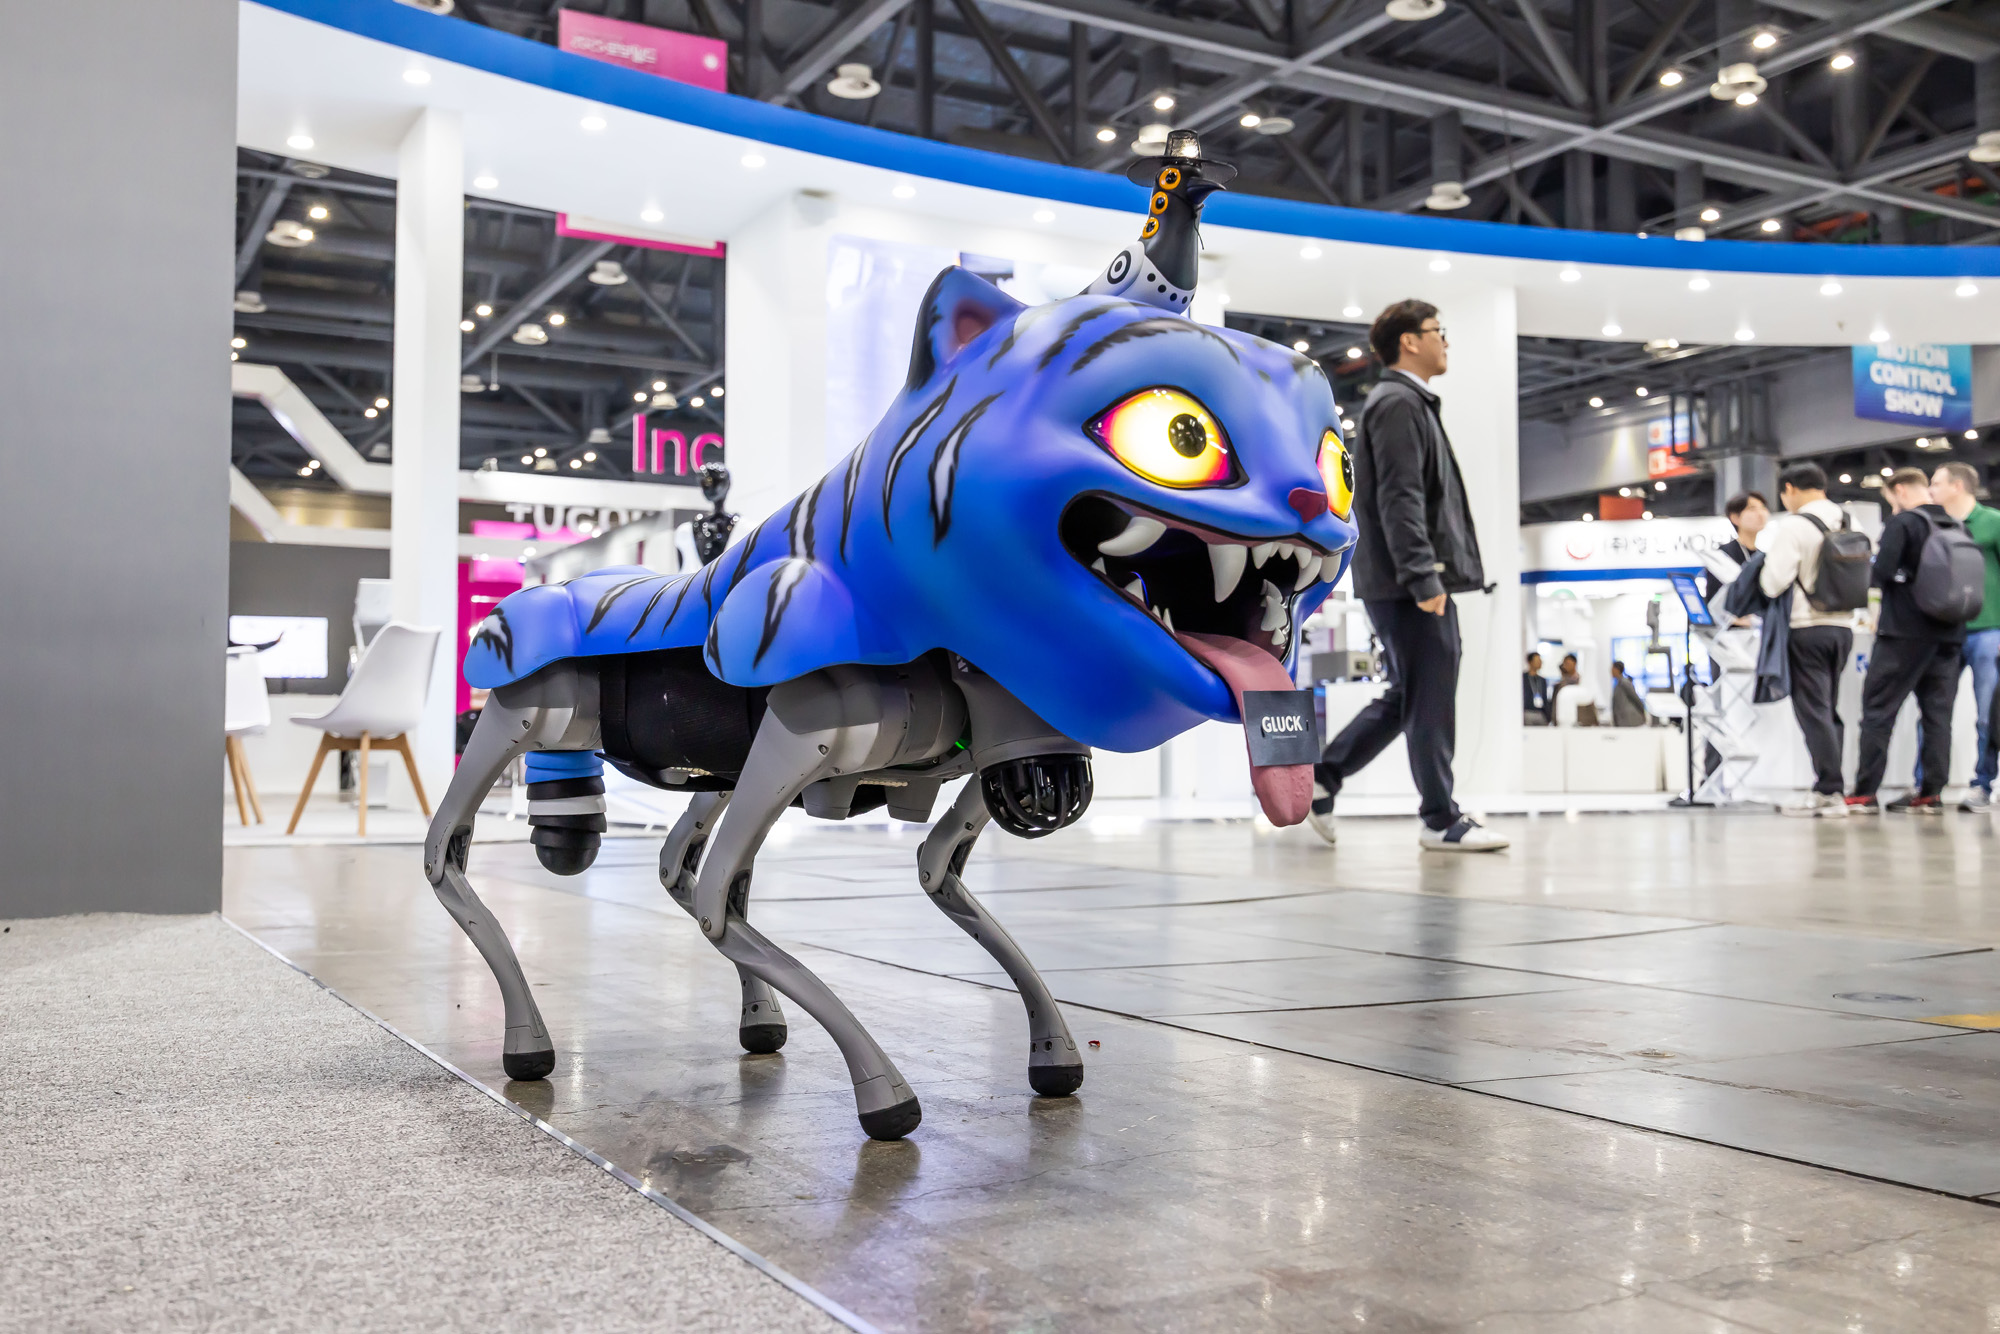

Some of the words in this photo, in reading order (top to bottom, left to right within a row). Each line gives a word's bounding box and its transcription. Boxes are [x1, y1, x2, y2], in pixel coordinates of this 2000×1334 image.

[1877, 344, 1949, 369] MOTION
[1870, 360, 1957, 396] CONTROL
[1884, 387, 1944, 418] SHOW
[1261, 715, 1303, 733] GLUCK
